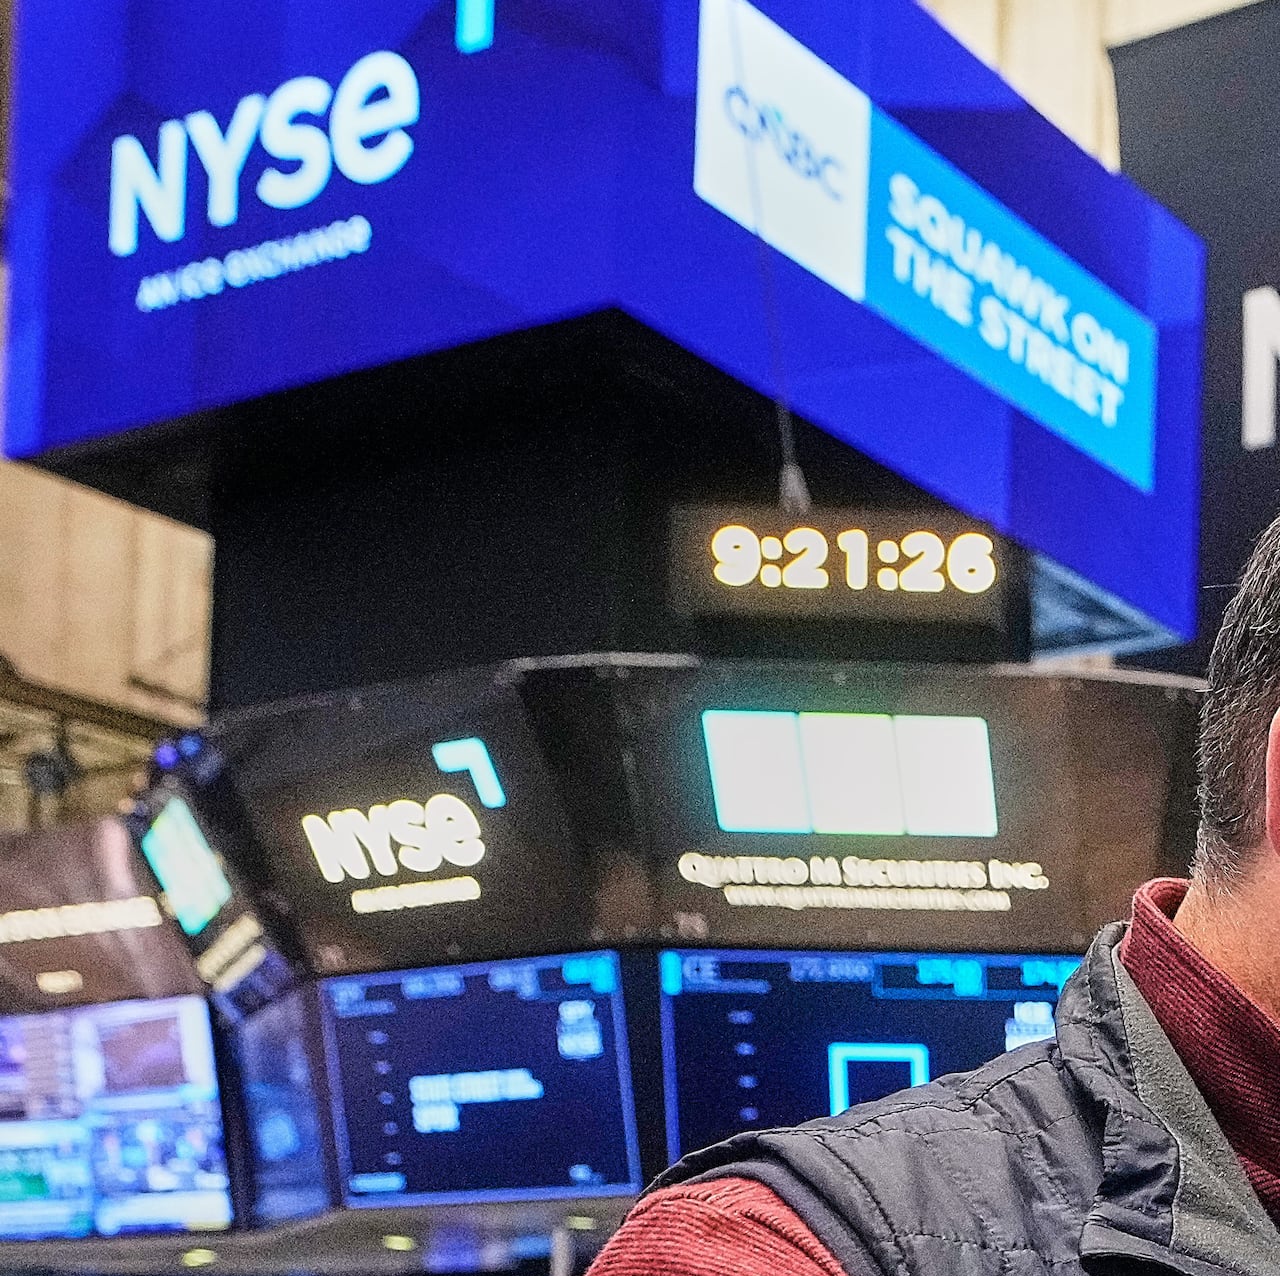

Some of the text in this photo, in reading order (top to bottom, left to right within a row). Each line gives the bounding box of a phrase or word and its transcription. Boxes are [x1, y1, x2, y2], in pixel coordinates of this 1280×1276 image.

[885, 226, 1125, 429] THE STREET
[888, 171, 1129, 386] SQUAWK ON
[710, 524, 997, 594] 9:21:26
